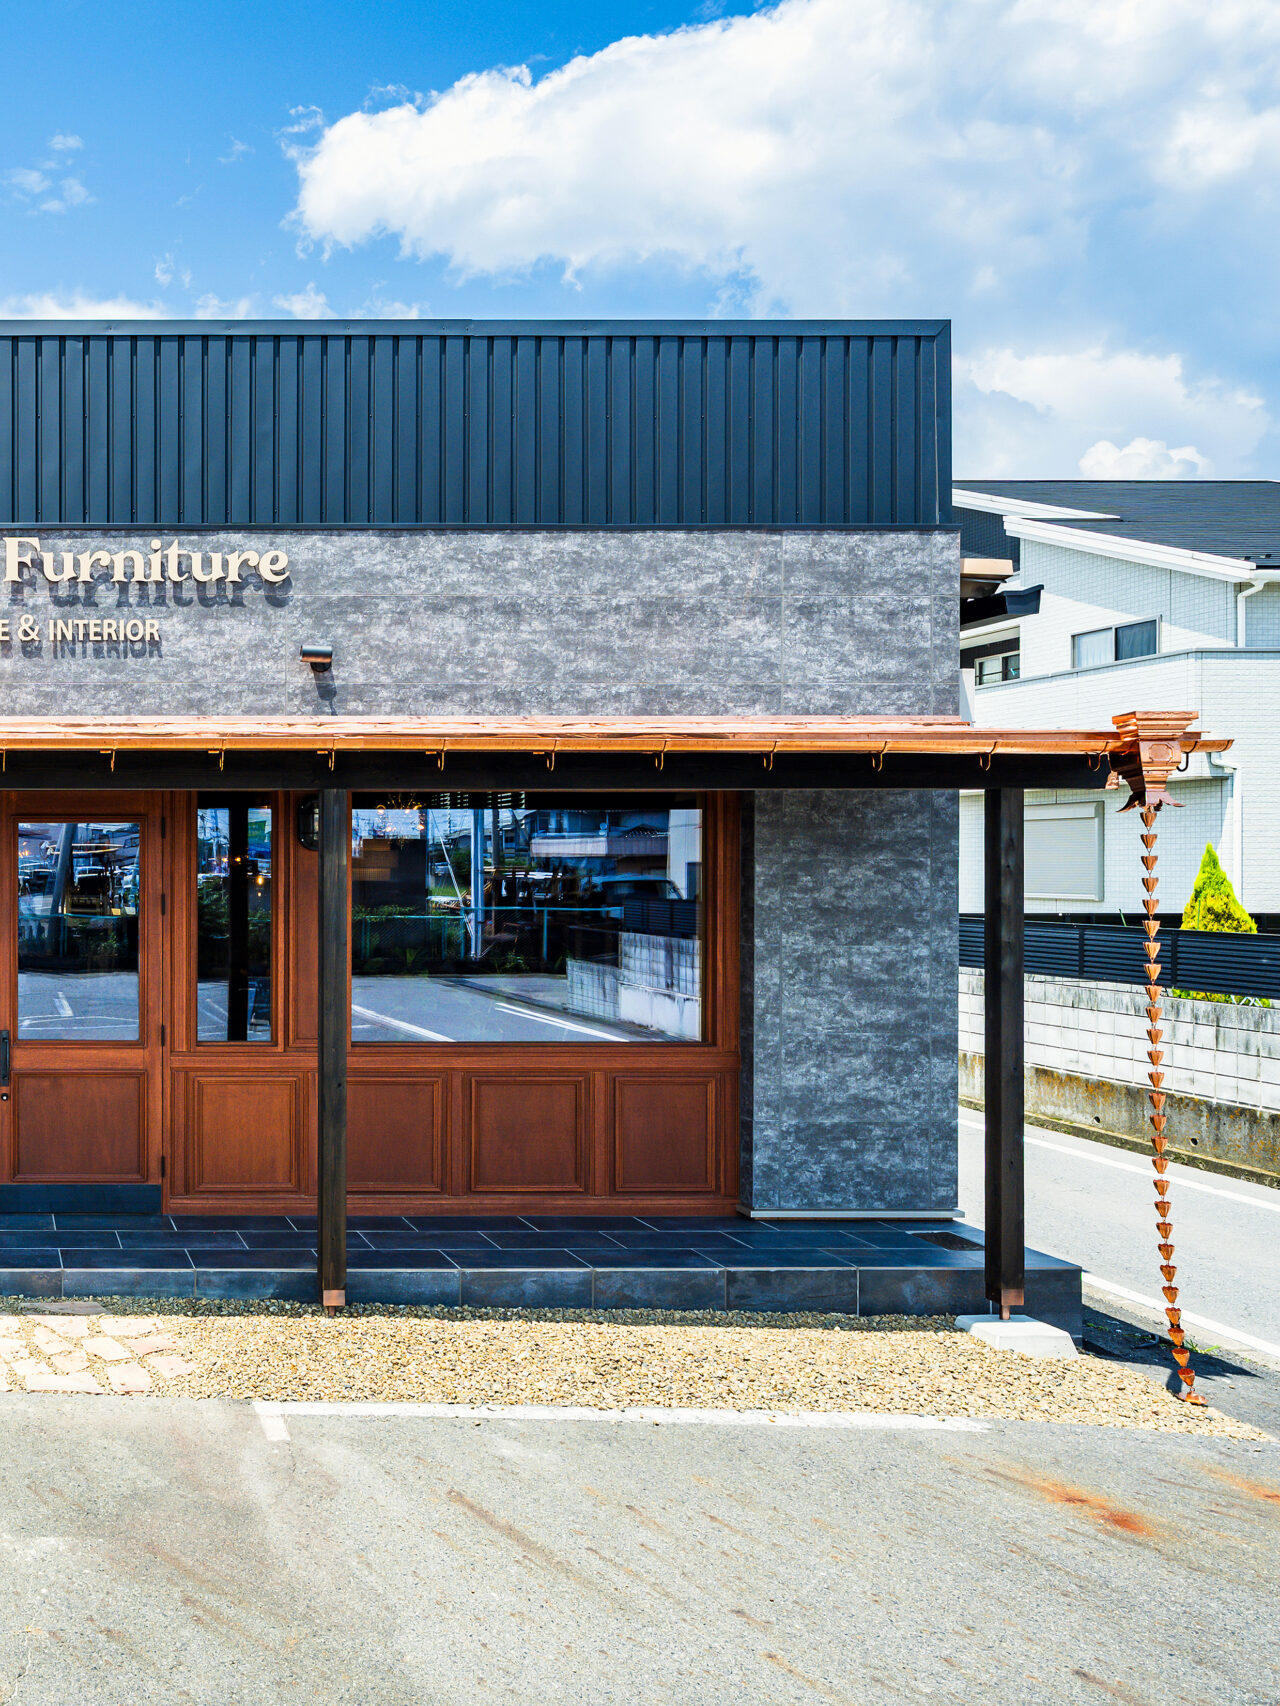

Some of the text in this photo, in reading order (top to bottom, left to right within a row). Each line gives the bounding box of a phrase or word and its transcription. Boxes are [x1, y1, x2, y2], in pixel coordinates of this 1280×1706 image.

[3, 537, 290, 583] Furniture
[17, 613, 40, 641] &
[48, 618, 160, 641] INTERIOR
